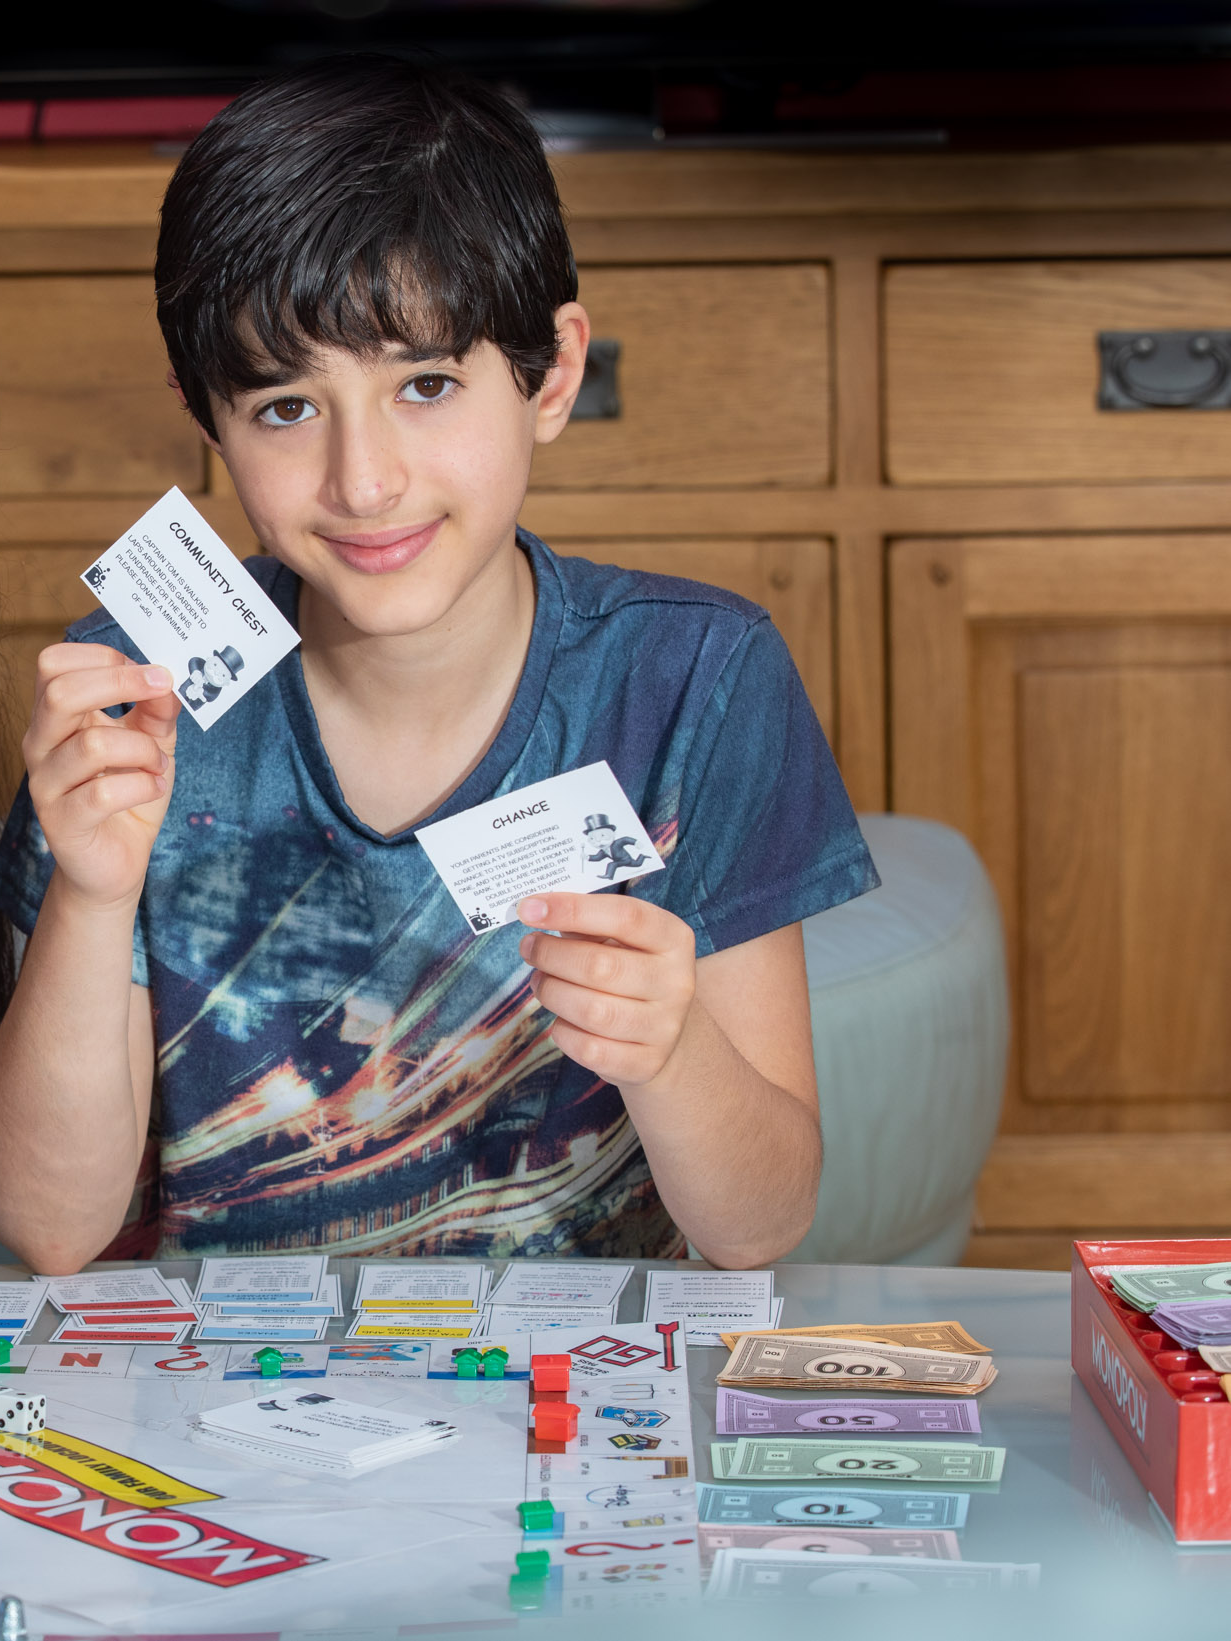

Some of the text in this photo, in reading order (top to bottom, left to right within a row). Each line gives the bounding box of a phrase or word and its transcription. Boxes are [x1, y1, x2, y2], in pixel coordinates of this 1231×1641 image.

[124, 548, 192, 631] FUNDRAISE FOR THE NHS.
[127, 534, 207, 630] LAPS AROUND HIS GARDEN TO
[141, 534, 210, 616] CAPTAIN TOM IS WALKING
[168, 521, 268, 637] COMMUNITY CHEST
[114, 553, 189, 641] PLEASE DONATE A MINIMUM
[130, 592, 142, 603] OF
[492, 799, 550, 829] CHANCE
[566, 1335, 663, 1369] GO
[816, 1361, 894, 1377] 100
[1092, 1323, 1147, 1444] MONOPOLY
[819, 1415, 878, 1426] 50
[87, 1461, 146, 1490] FAMILY
[838, 1458, 899, 1470] 20
[136, 1485, 177, 1502] OUR
[802, 1503, 856, 1516] 10
